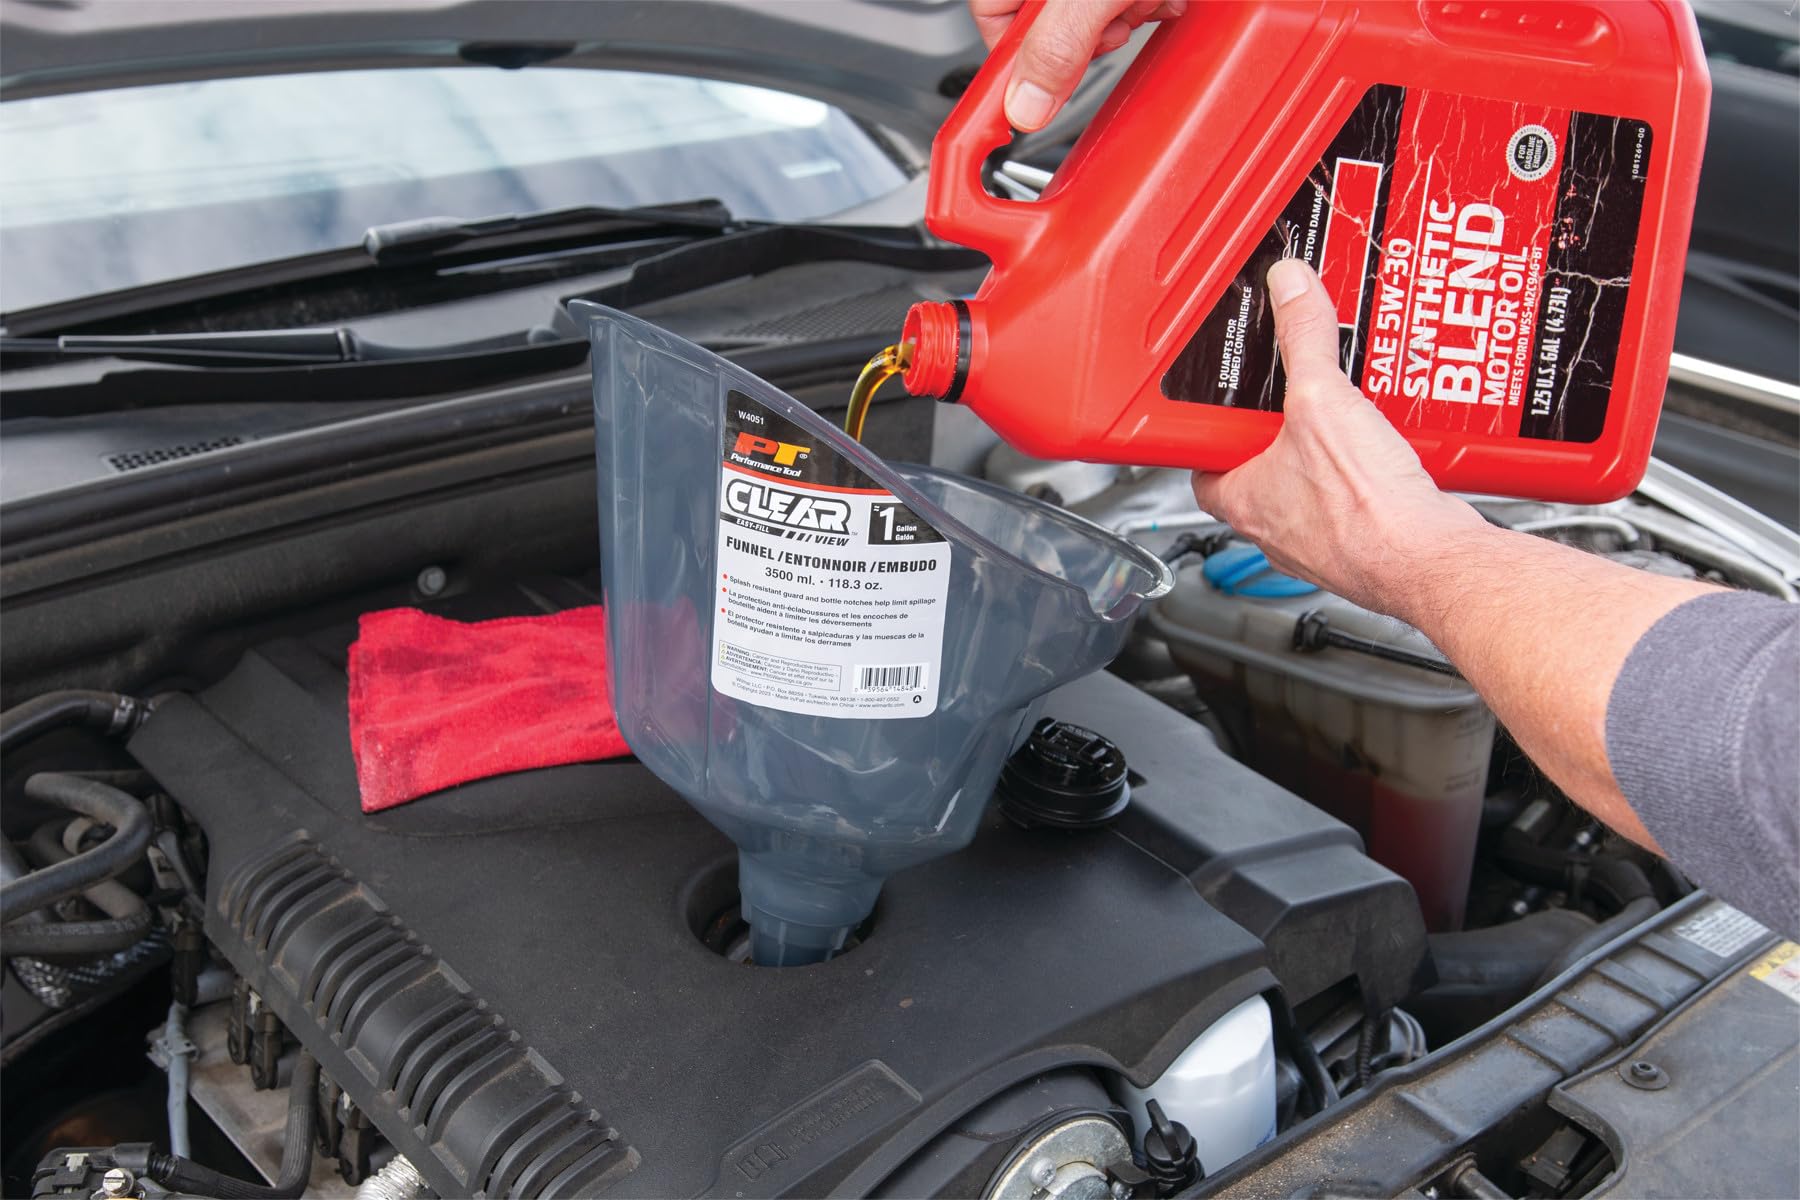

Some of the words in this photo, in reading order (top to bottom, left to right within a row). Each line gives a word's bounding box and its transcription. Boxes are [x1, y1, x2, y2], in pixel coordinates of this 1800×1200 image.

[1518, 144, 1526, 159] FOR
[1524, 136, 1536, 170] GASOLINE
[1532, 139, 1544, 168] ENGINES
[1632, 128, 1646, 180] 1081269-00
[1310, 184, 1324, 228] DAMAGE
[1500, 246, 1528, 294] OIL
[1376, 238, 1412, 332] 5W-30
[1403, 199, 1456, 400] SYNTHETIC
[1432, 202, 1505, 404] BLEND
[1545, 287, 1572, 332] (4.73L)
[1226, 318, 1238, 338] FOR
[1234, 286, 1252, 350] CONVENIENCE
[1220, 340, 1234, 380] QUARTS
[1482, 299, 1520, 406] MOTOR
[1514, 336, 1528, 365] FORD
[1540, 338, 1560, 361] GAL
[1228, 350, 1242, 390] ADDED
[1368, 334, 1398, 395] SAE
[1536, 364, 1556, 388] U.S.
[1218, 380, 1227, 388] 5
[1508, 366, 1524, 406] MEETS
[738, 410, 764, 424] W4051
[1531, 390, 1552, 415] 1.25
[734, 432, 811, 466] PT
[730, 452, 782, 474] Performance
[782, 466, 802, 477] Tool
[726, 478, 851, 535] CLEAR
[736, 518, 770, 534] EASY-FILL
[814, 536, 850, 546] VIEW
[726, 536, 774, 560] FUNNEL
[730, 576, 751, 588] Splash
[752, 582, 782, 596] resistant
[783, 591, 804, 600] guard
[820, 596, 842, 604] bottle
[844, 598, 872, 606] notches
[874, 598, 890, 607] help
[909, 598, 936, 606] spillage
[765, 567, 793, 582] 3500
[797, 575, 815, 586] ml.
[828, 578, 860, 590] 118.3
[864, 582, 882, 590] oz.
[728, 598, 755, 610] bouteille
[757, 607, 777, 616] aident
[785, 613, 807, 622] limiter
[821, 618, 872, 627] déversements
[738, 593, 770, 607] protection
[772, 602, 840, 618] anti-éclaboussures
[728, 618, 748, 629] botella
[749, 625, 774, 636] ayudan
[781, 632, 803, 642] limitar
[818, 638, 851, 647] derrames
[735, 613, 764, 626] protector
[766, 622, 800, 634] resistente
[808, 630, 854, 640] salpicaduras
[727, 645, 751, 656] WARNING:
